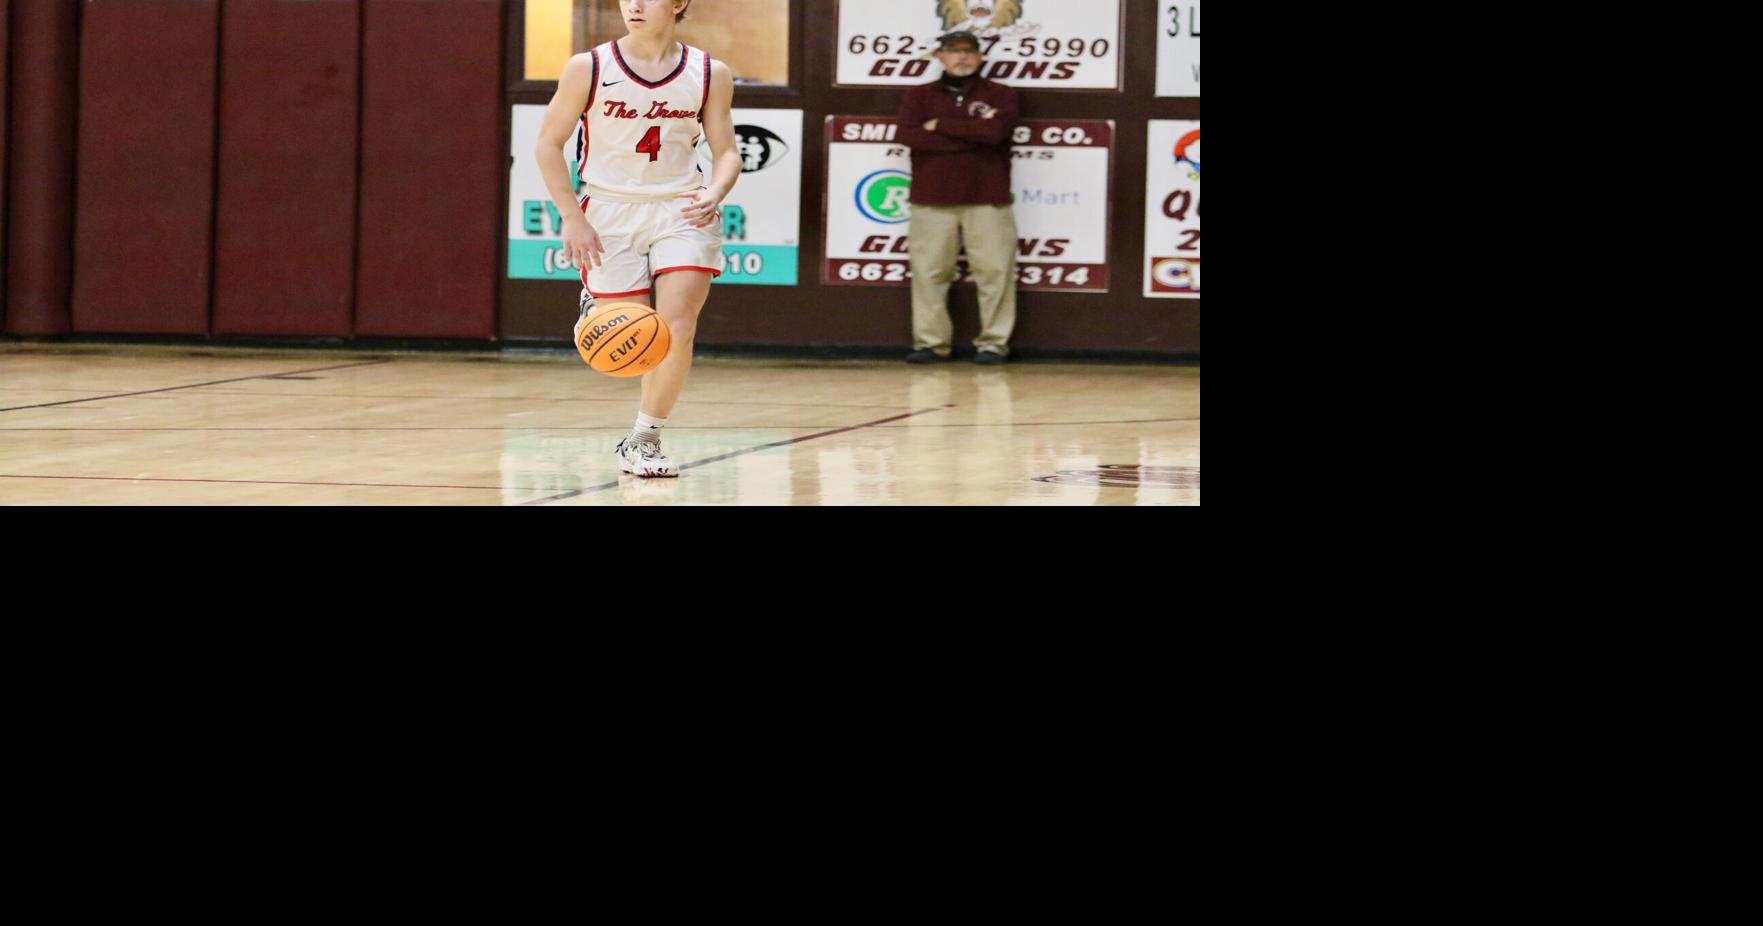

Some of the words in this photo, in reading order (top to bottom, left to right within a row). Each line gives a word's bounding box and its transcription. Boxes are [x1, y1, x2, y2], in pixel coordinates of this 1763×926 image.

[1167, 6, 1180, 37] 3
[849, 35, 1109, 58] 662-7-5990
[869, 58, 930, 77] GO
[603, 100, 638, 119] The
[643, 101, 696, 120] Grove
[636, 126, 661, 162] 4
[1041, 126, 1093, 144] CO.
[1022, 189, 1080, 205] Mart
[581, 314, 629, 351] Wilson
